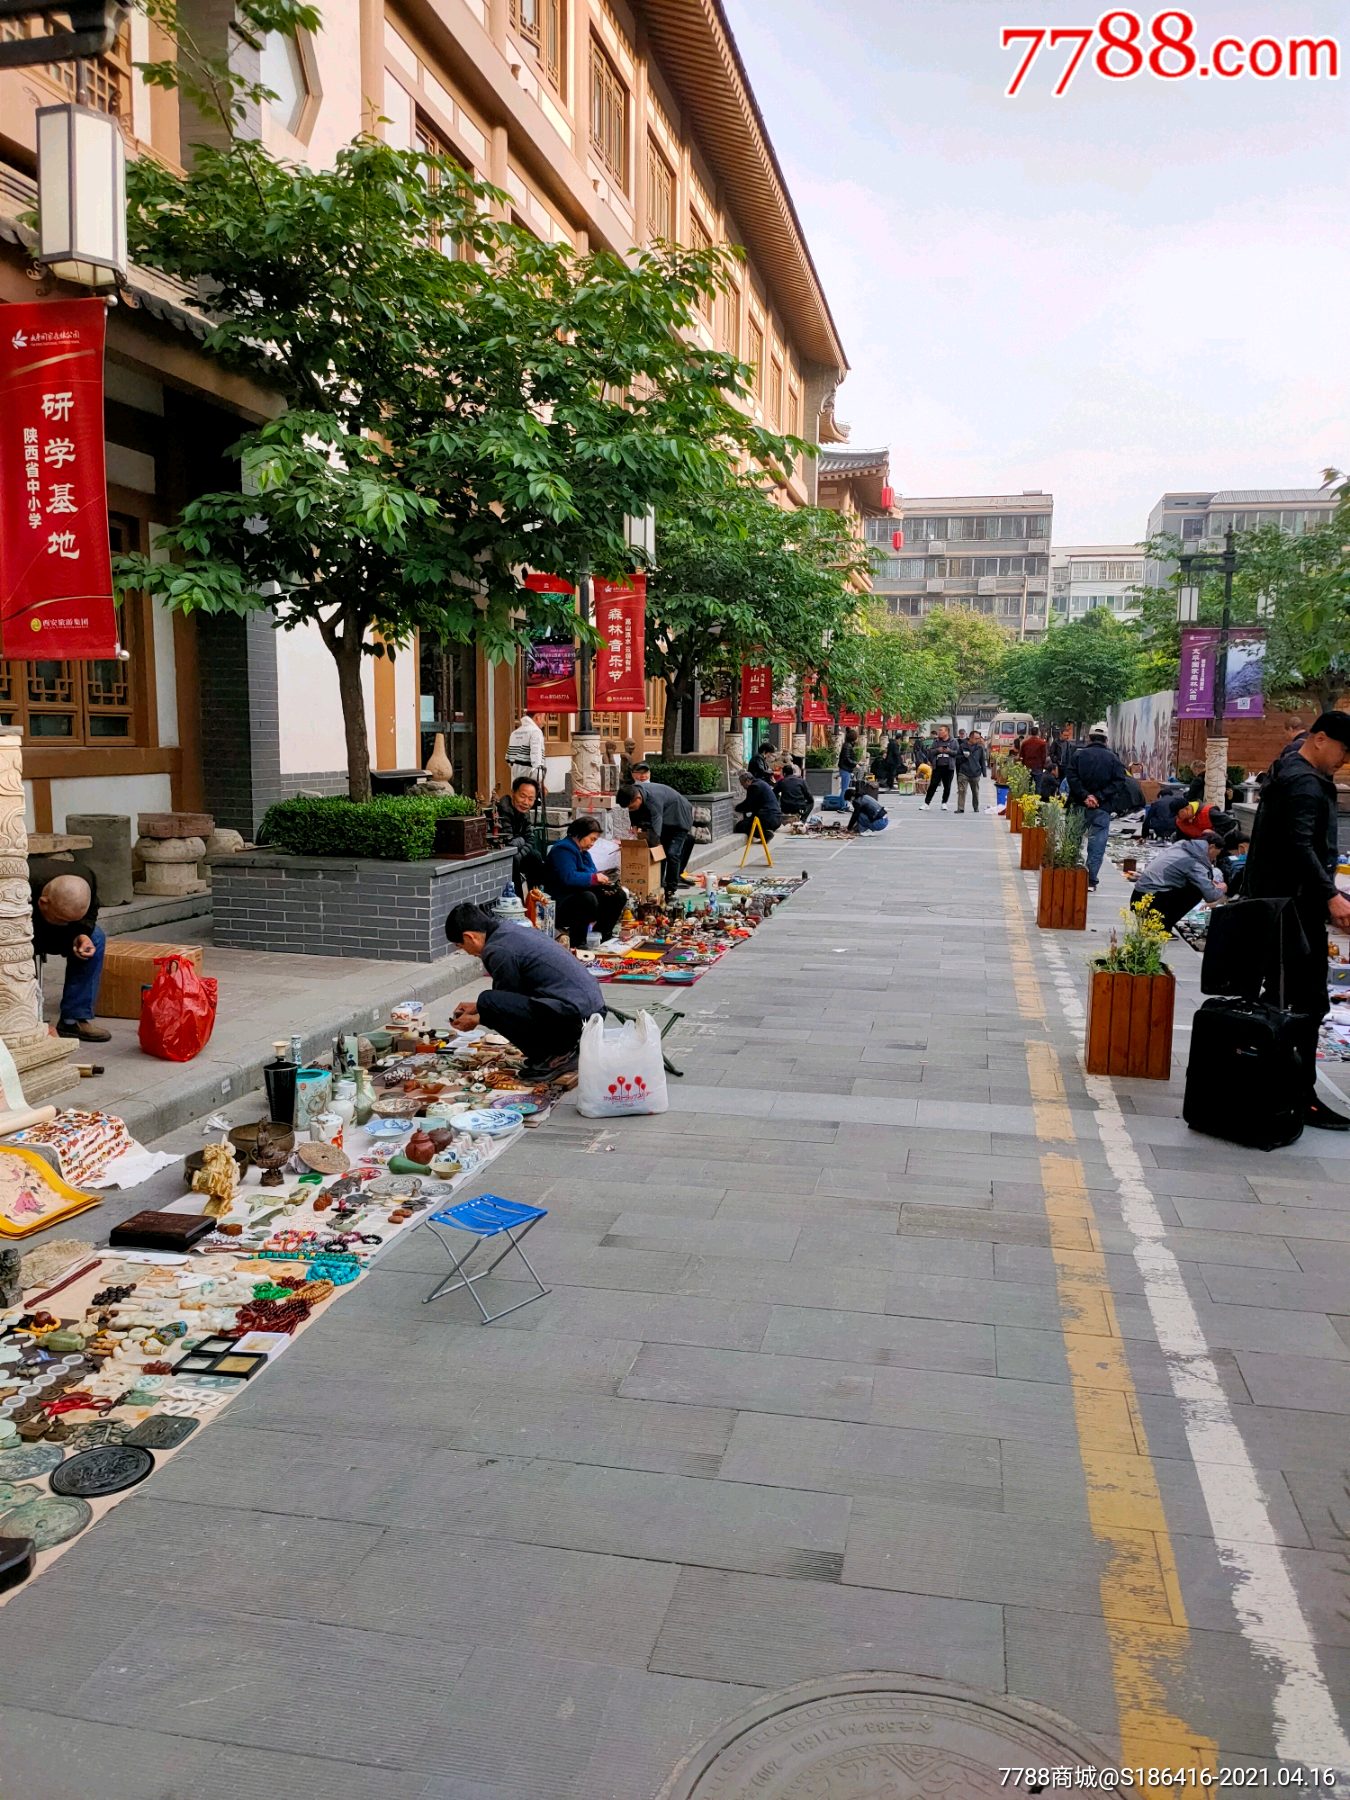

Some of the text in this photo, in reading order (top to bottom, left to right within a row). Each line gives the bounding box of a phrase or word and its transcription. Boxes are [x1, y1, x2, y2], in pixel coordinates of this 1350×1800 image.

[24, 428, 42, 529] 陕西省中小学
[41, 391, 80, 560] 研学基地
[608, 608, 623, 683] 森林音乐节
